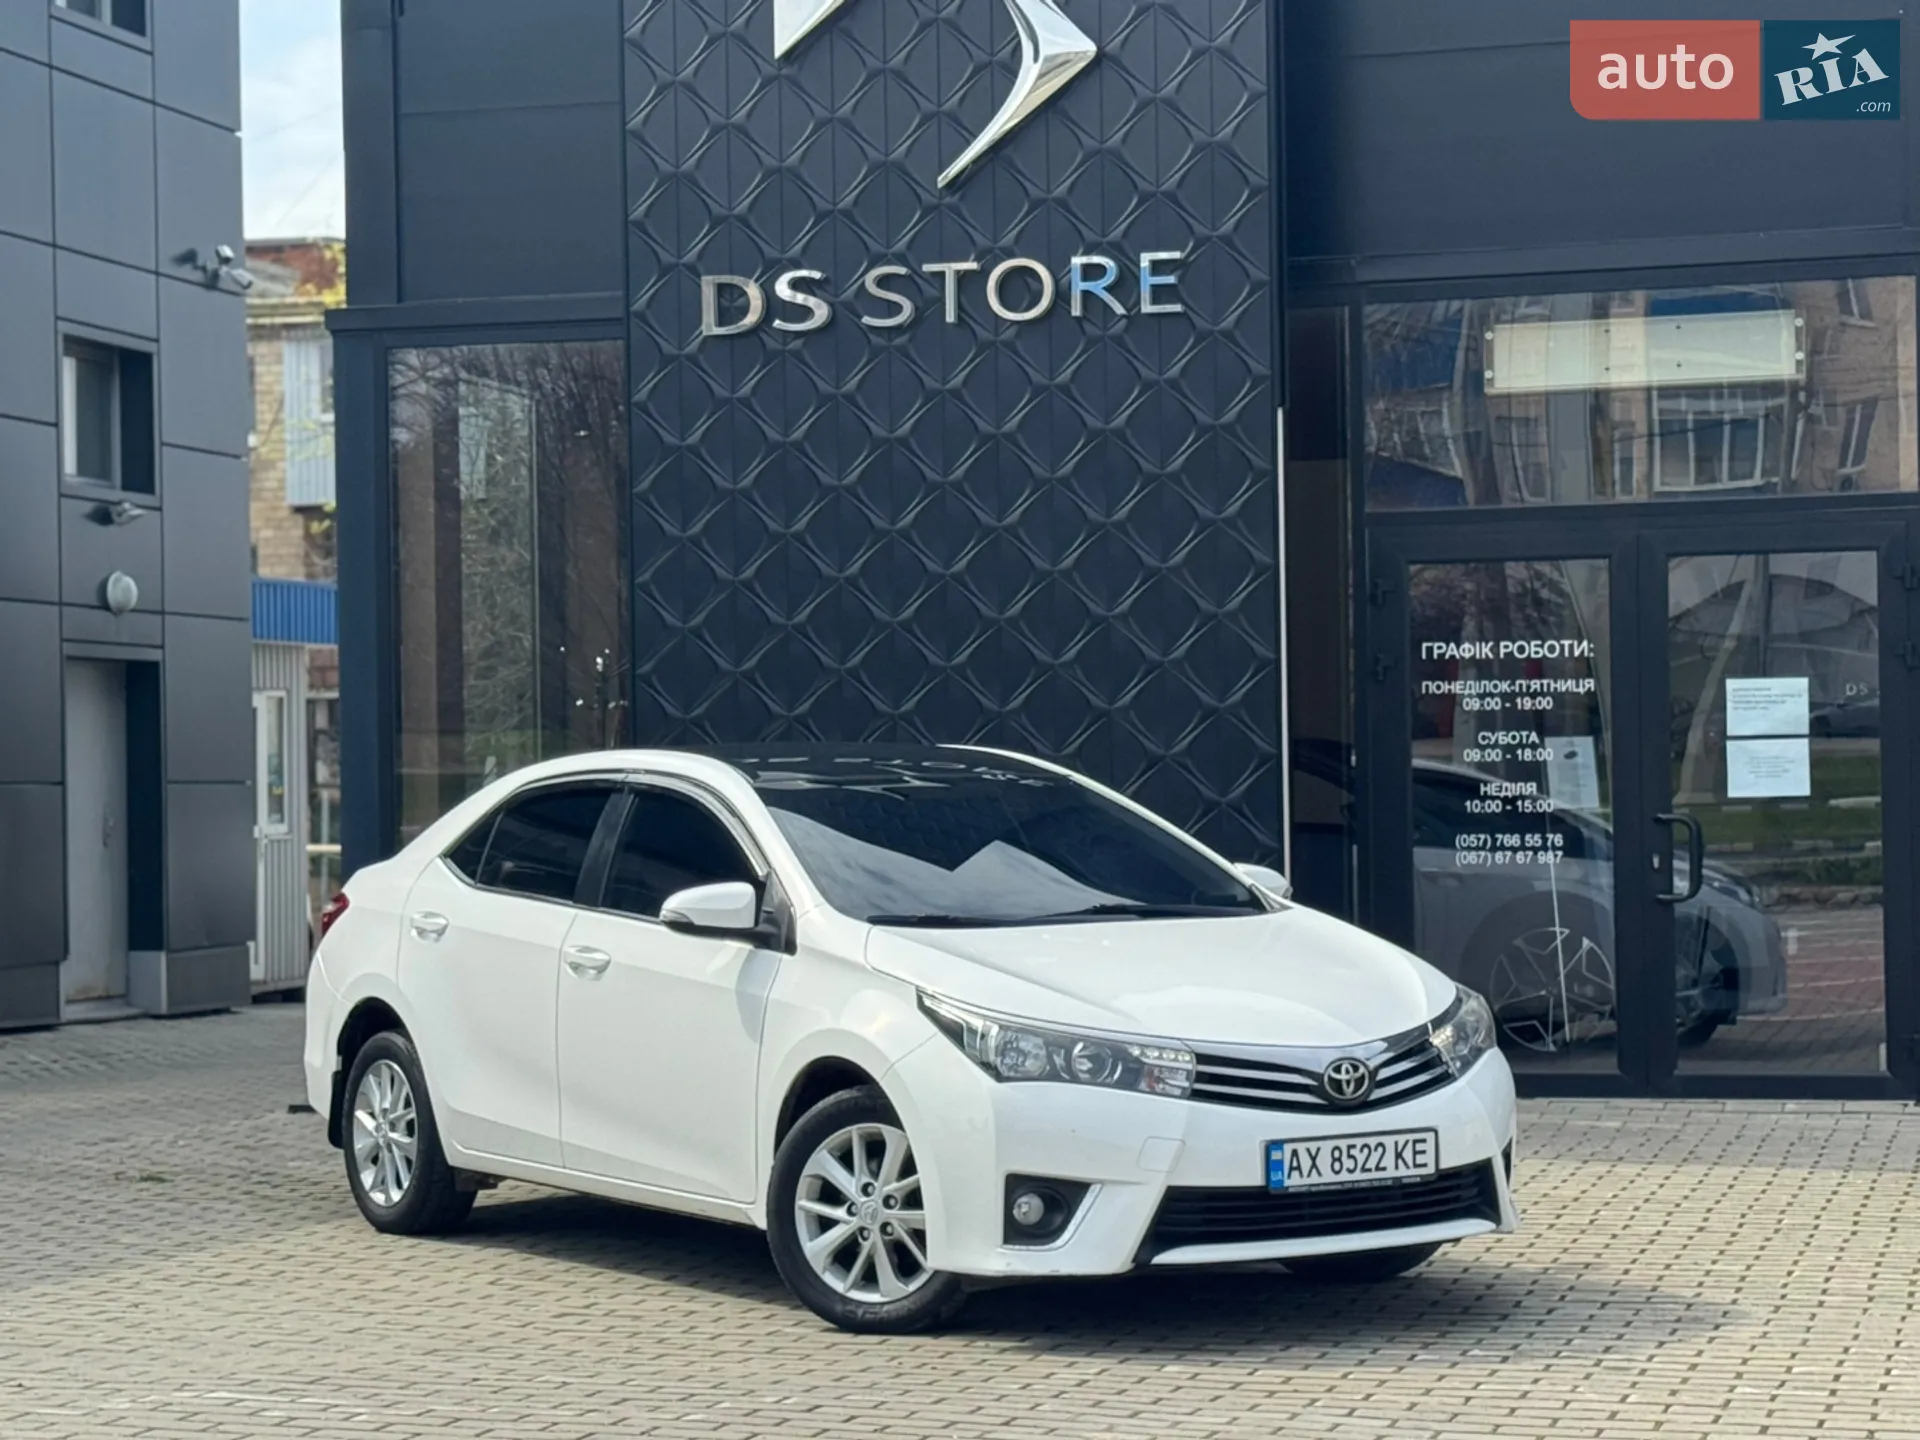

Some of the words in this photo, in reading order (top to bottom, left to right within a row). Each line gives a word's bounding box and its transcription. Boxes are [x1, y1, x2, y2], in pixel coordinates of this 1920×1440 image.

[700, 268, 833, 336] DS
[861, 251, 1185, 327] STORE
[1421, 641, 1494, 660] ГРАФІК
[1499, 638, 1595, 659] РОБОТИ:
[1462, 697, 1502, 711] 09:00
[1515, 696, 1553, 711] 19:00
[1477, 730, 1540, 745] СУБОТА
[1463, 748, 1502, 762] 09:00
[1516, 747, 1554, 762] 18:00
[1480, 781, 1537, 798] НЕДІЛЯ
[1464, 799, 1502, 813] 10:00
[1516, 799, 1554, 813] 15:00
[1455, 833, 1492, 850] (057)
[1494, 833, 1521, 848] 766
[1524, 833, 1542, 847] 55
[1546, 833, 1563, 847] 76
[1455, 850, 1492, 867] (067)
[1495, 850, 1512, 865] 67
[1516, 850, 1533, 864] 67
[1537, 850, 1563, 864] 987
[1287, 1147, 1323, 1180] AX
[1330, 1142, 1387, 1175] 8522
[1394, 1138, 1428, 1171] KE
